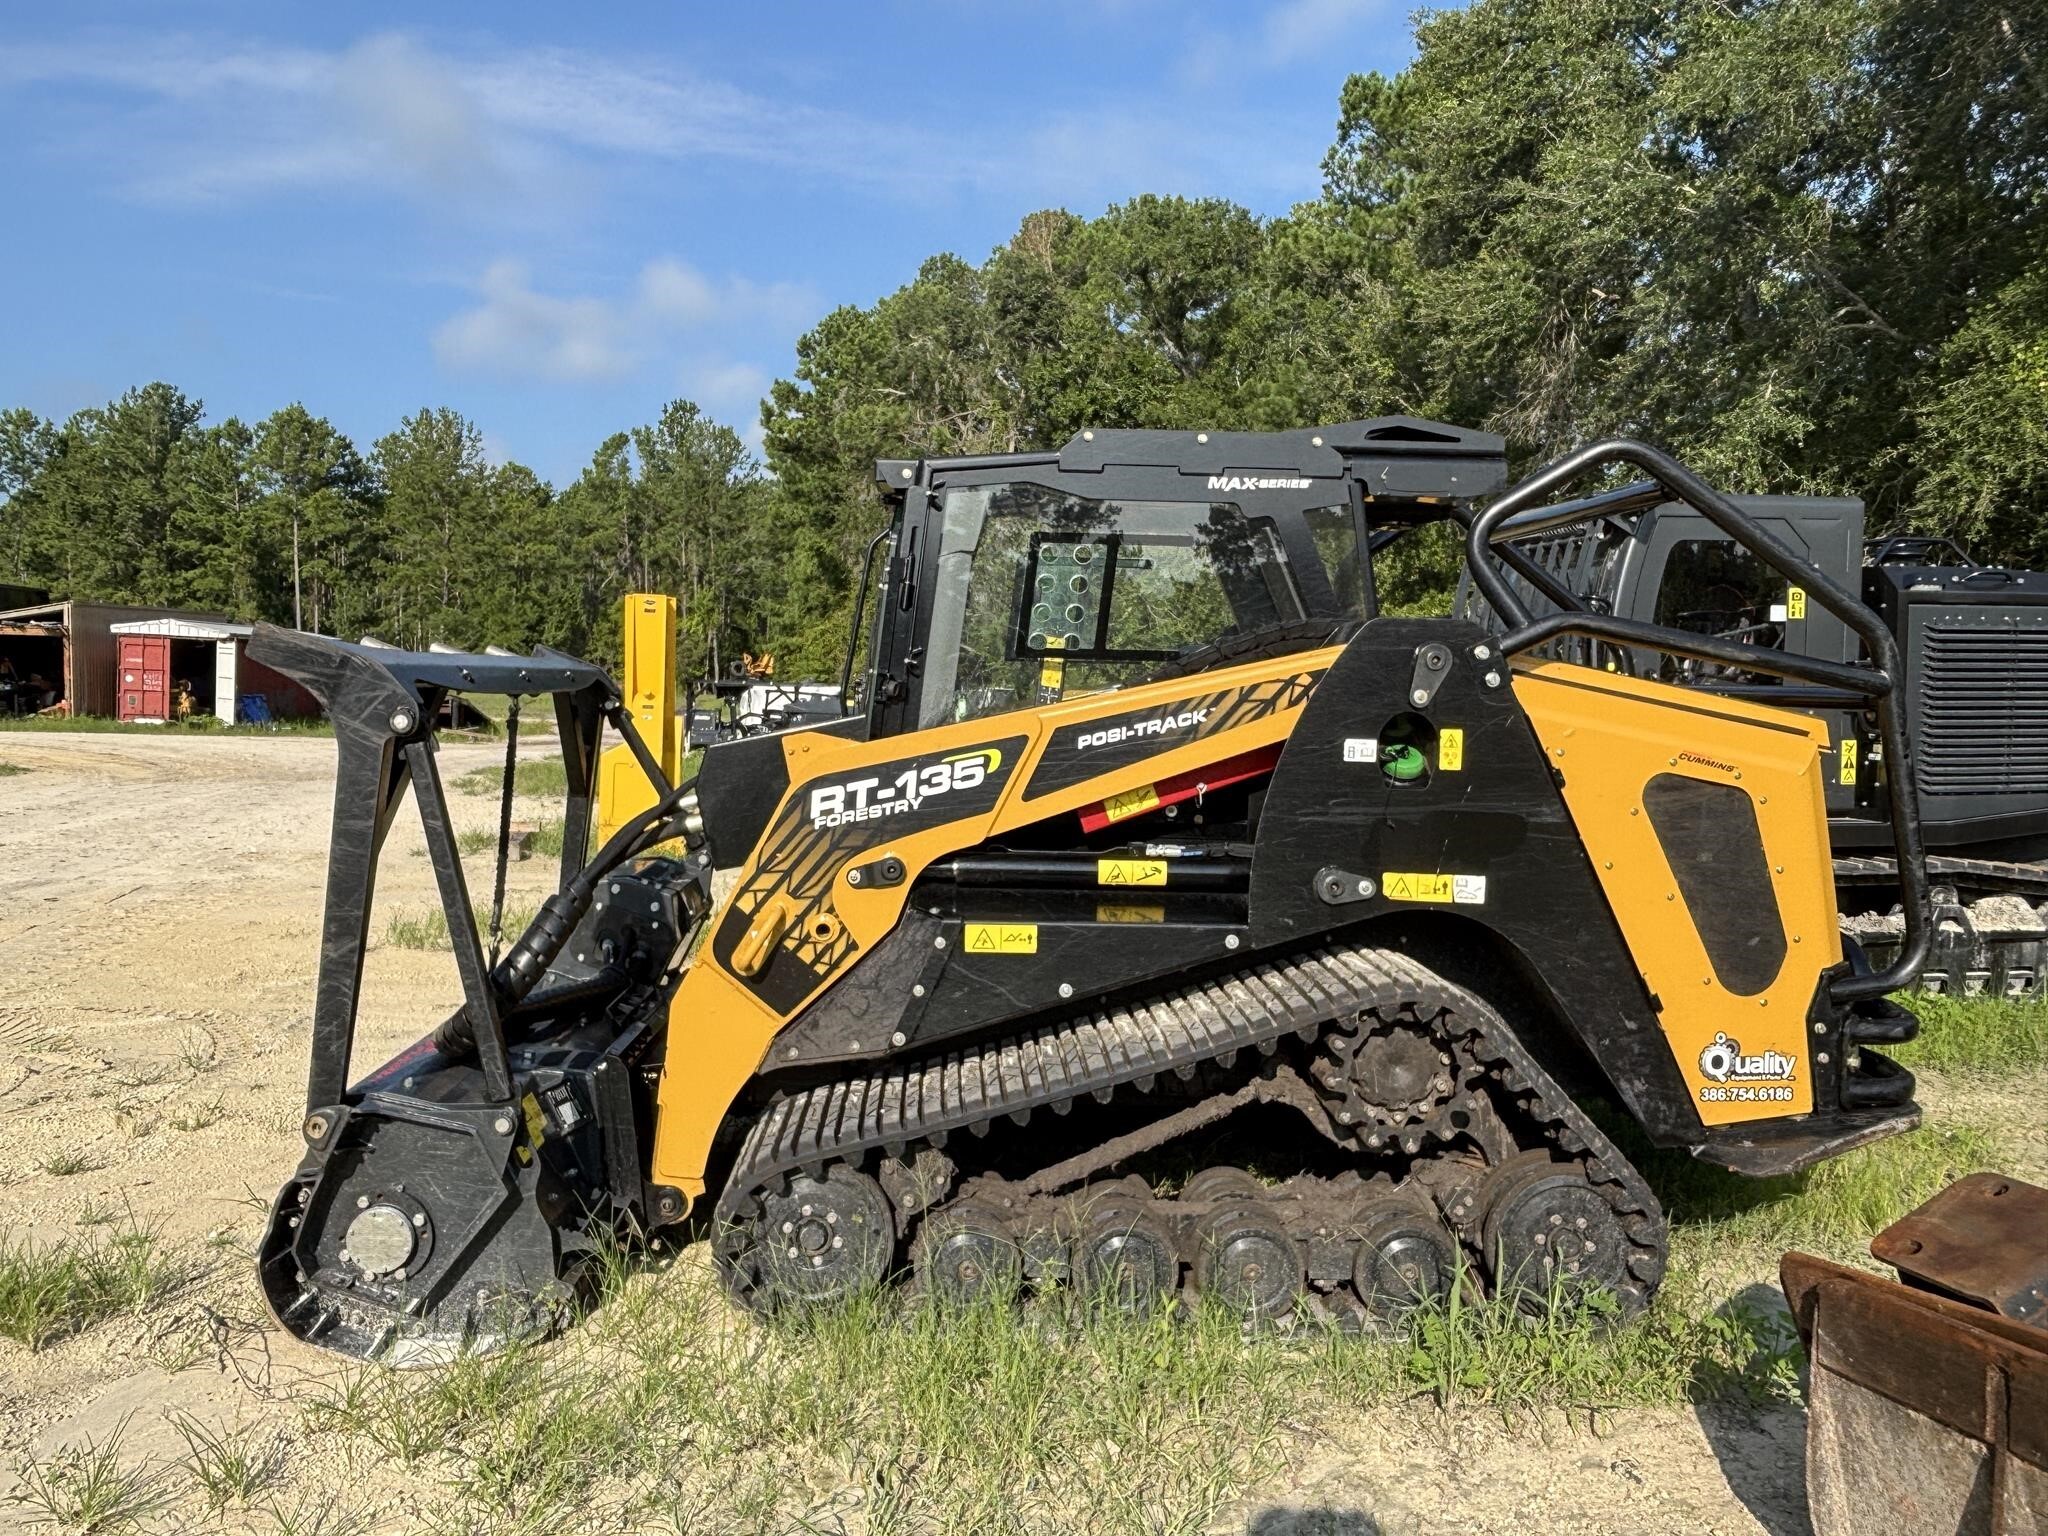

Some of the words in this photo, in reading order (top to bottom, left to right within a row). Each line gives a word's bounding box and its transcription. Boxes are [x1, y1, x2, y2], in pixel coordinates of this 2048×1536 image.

[1207, 476, 1311, 491] MAX-SERIES
[1077, 709, 1208, 750] POSI-TRACK
[1678, 752, 1735, 772] CUMMINS
[810, 756, 985, 820] RT-135
[814, 796, 924, 830] FORESTRY
[1704, 1049, 1797, 1084] Quality
[1700, 1087, 1793, 1102] 386.754.6186
